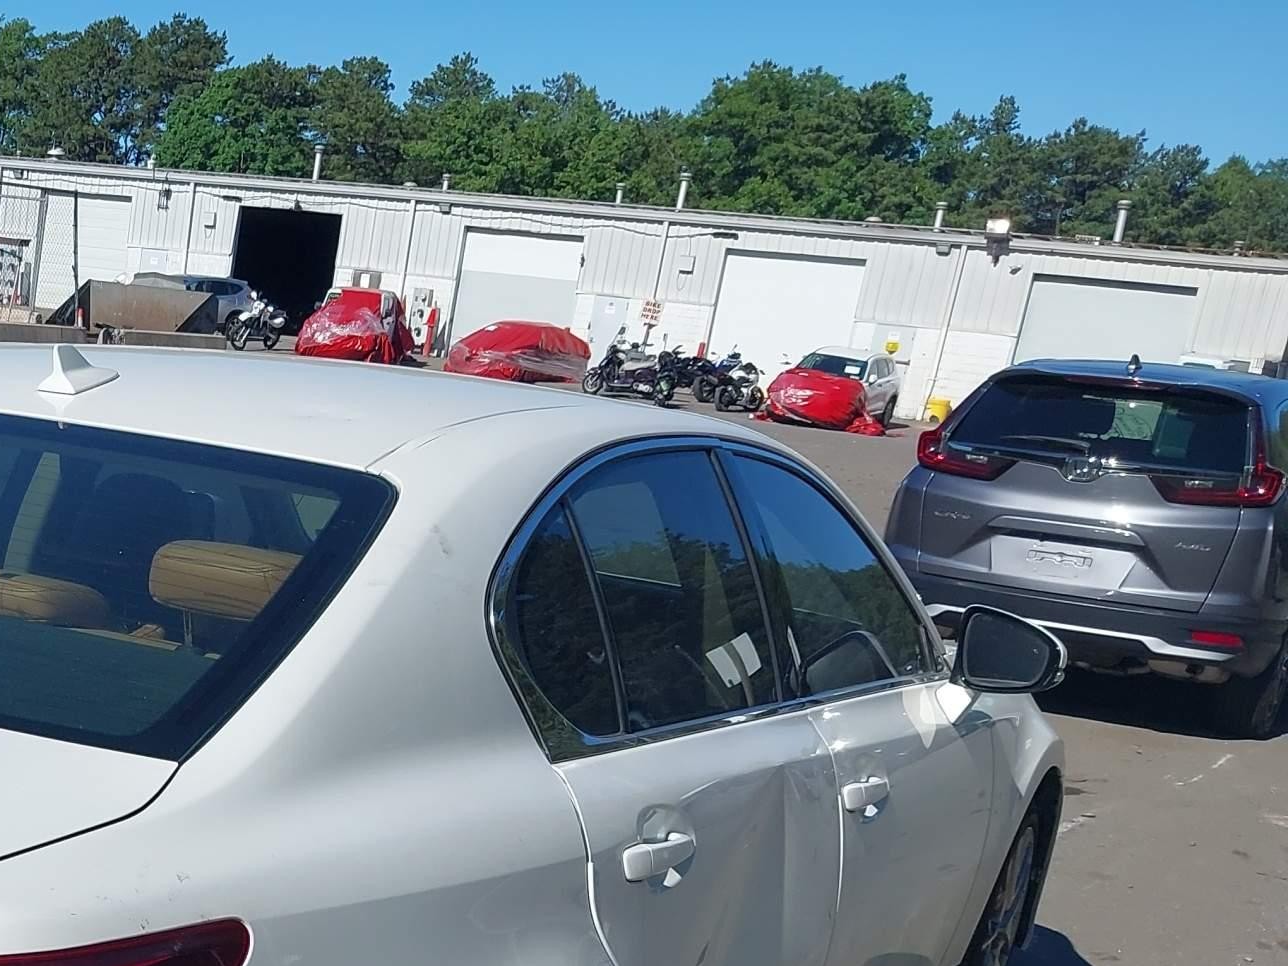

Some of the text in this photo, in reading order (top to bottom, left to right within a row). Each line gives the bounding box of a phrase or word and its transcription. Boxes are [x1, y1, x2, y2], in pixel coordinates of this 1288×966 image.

[645, 301, 662, 309] BIKE
[643, 307, 661, 315] DROP
[641, 312, 659, 321] HERE
